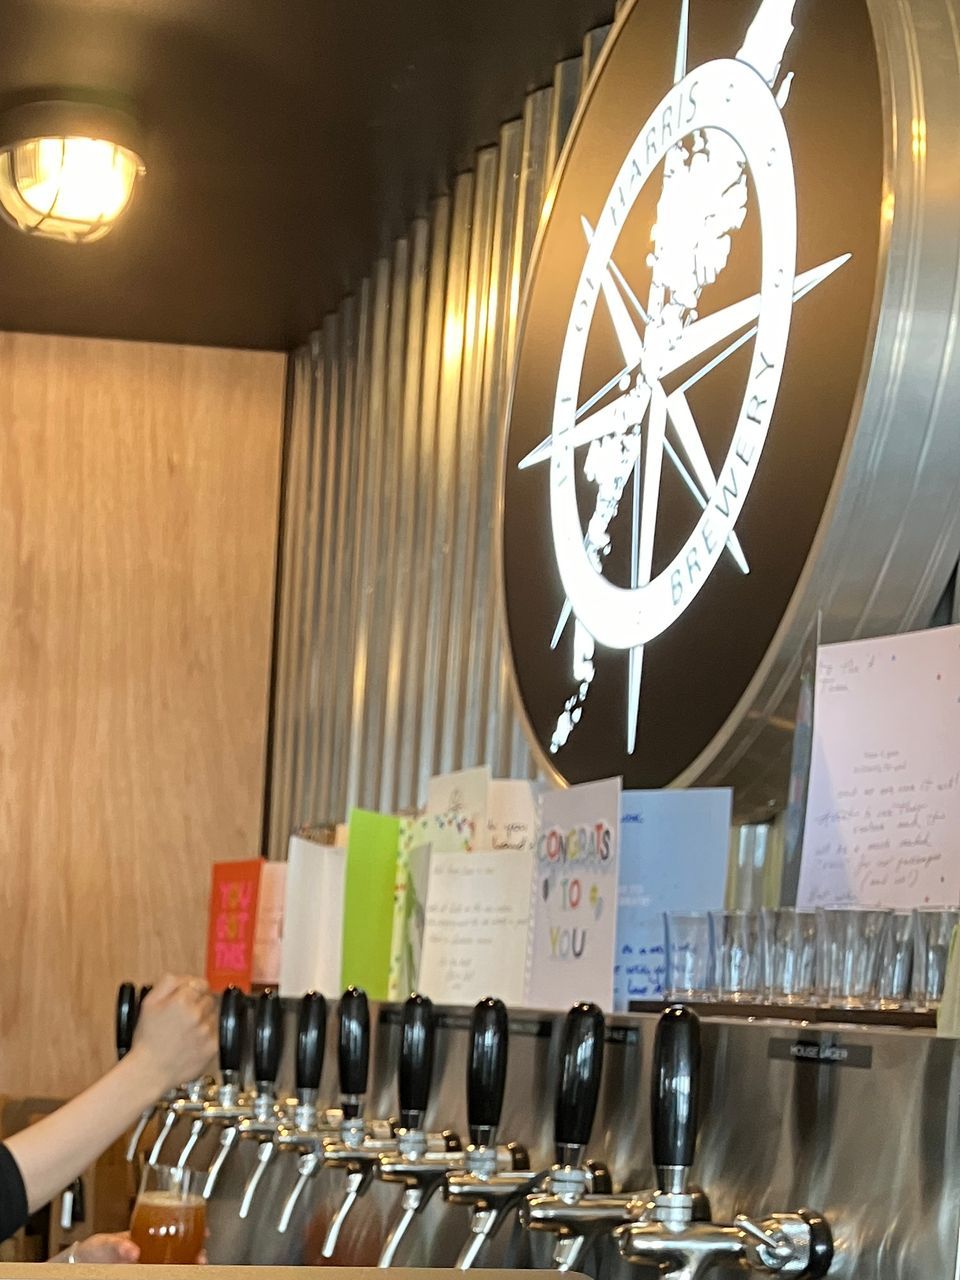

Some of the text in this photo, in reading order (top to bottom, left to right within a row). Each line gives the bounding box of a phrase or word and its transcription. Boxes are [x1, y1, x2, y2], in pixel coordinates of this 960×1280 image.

[670, 351, 775, 607] BREWERY
[537, 822, 611, 864] CONGRATS
[561, 878, 582, 911] TO
[549, 926, 586, 960] YOU
[790, 1043, 819, 1058] HOUSE
